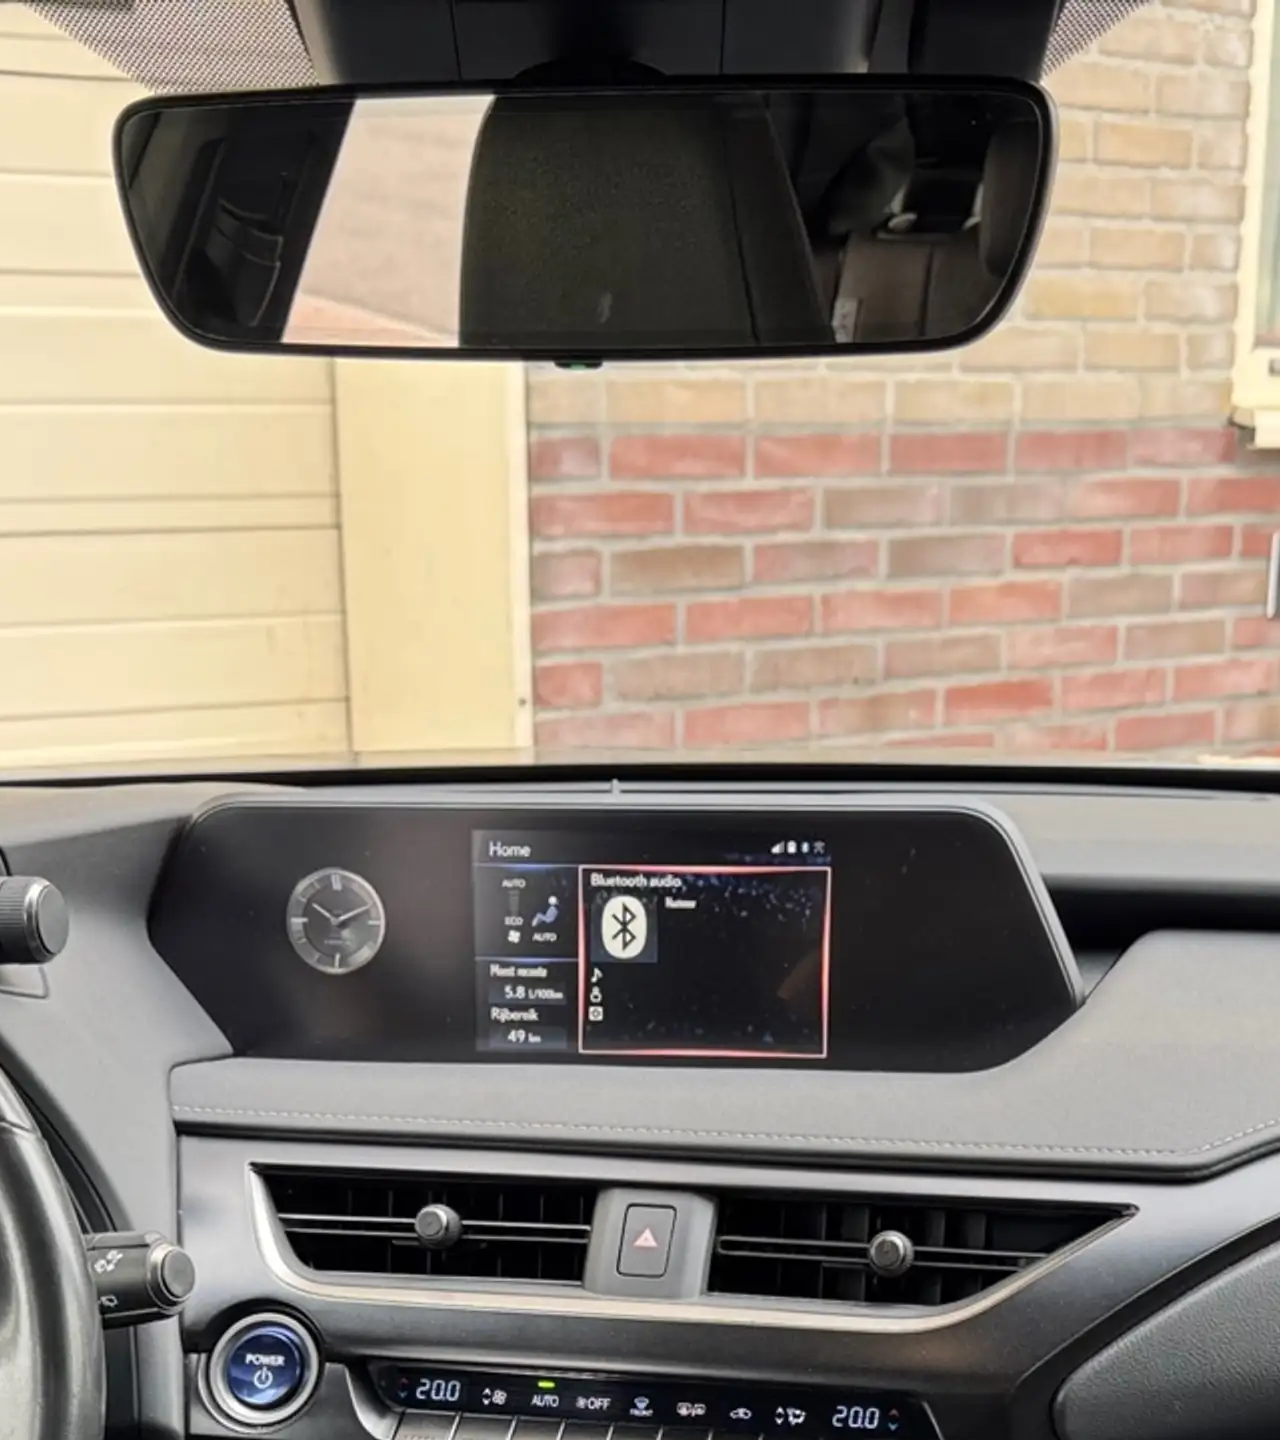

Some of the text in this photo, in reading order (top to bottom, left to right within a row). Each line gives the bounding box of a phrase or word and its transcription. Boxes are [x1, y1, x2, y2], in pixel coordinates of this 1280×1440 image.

[488, 840, 532, 858] Home
[501, 878, 527, 888] AUTO
[589, 871, 682, 888] Bluetooth audio
[503, 915, 524, 926] ECO
[531, 931, 558, 942] AUTO
[503, 984, 526, 999] 5.8
[507, 1028, 526, 1043] 49
[244, 1352, 287, 1367] POWER
[415, 1377, 462, 1403] 20.0
[530, 1394, 560, 1409] AUTO
[587, 1397, 613, 1411] OFF
[831, 1405, 880, 1430] 20.0
